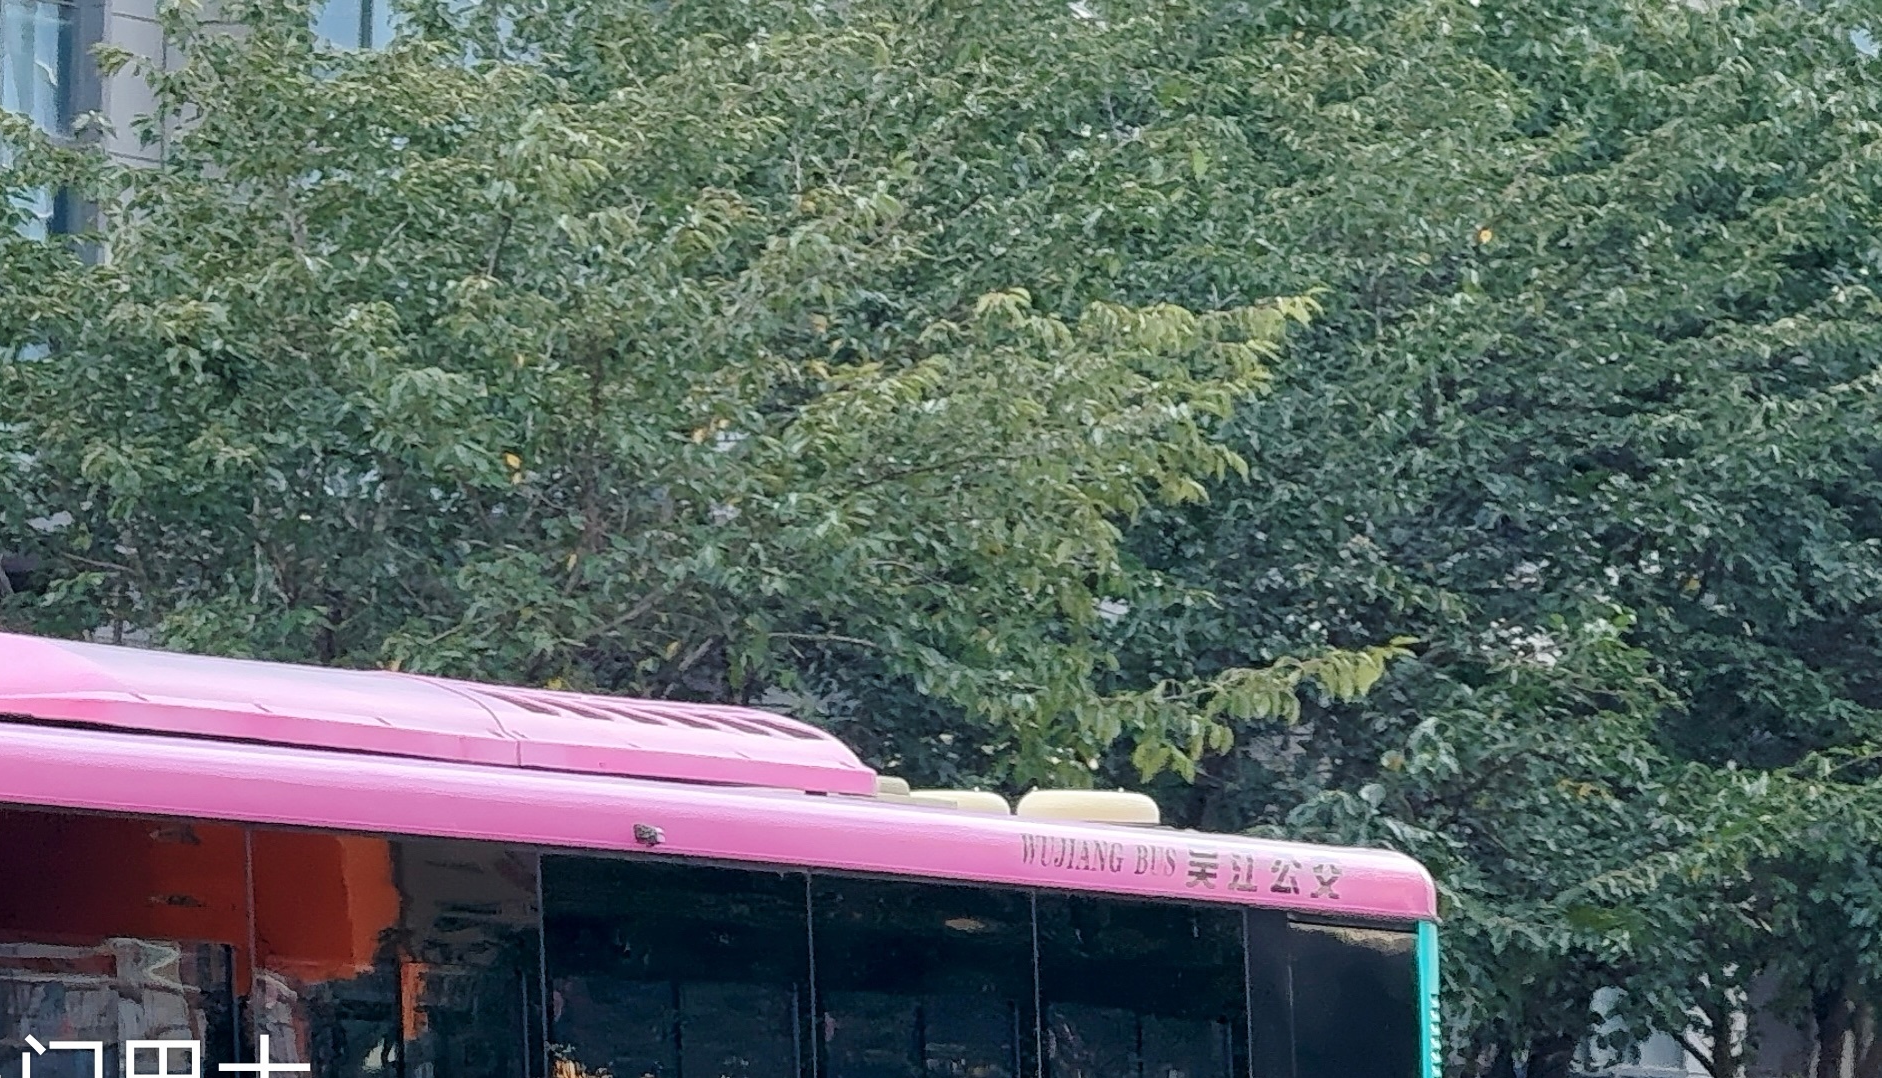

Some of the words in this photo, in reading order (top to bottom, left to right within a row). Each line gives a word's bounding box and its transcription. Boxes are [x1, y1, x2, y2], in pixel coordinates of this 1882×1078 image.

[1021, 833, 1123, 874] WUJIANG
[1134, 843, 1177, 879] BUS
[1185, 846, 1343, 900] 吴江公交
